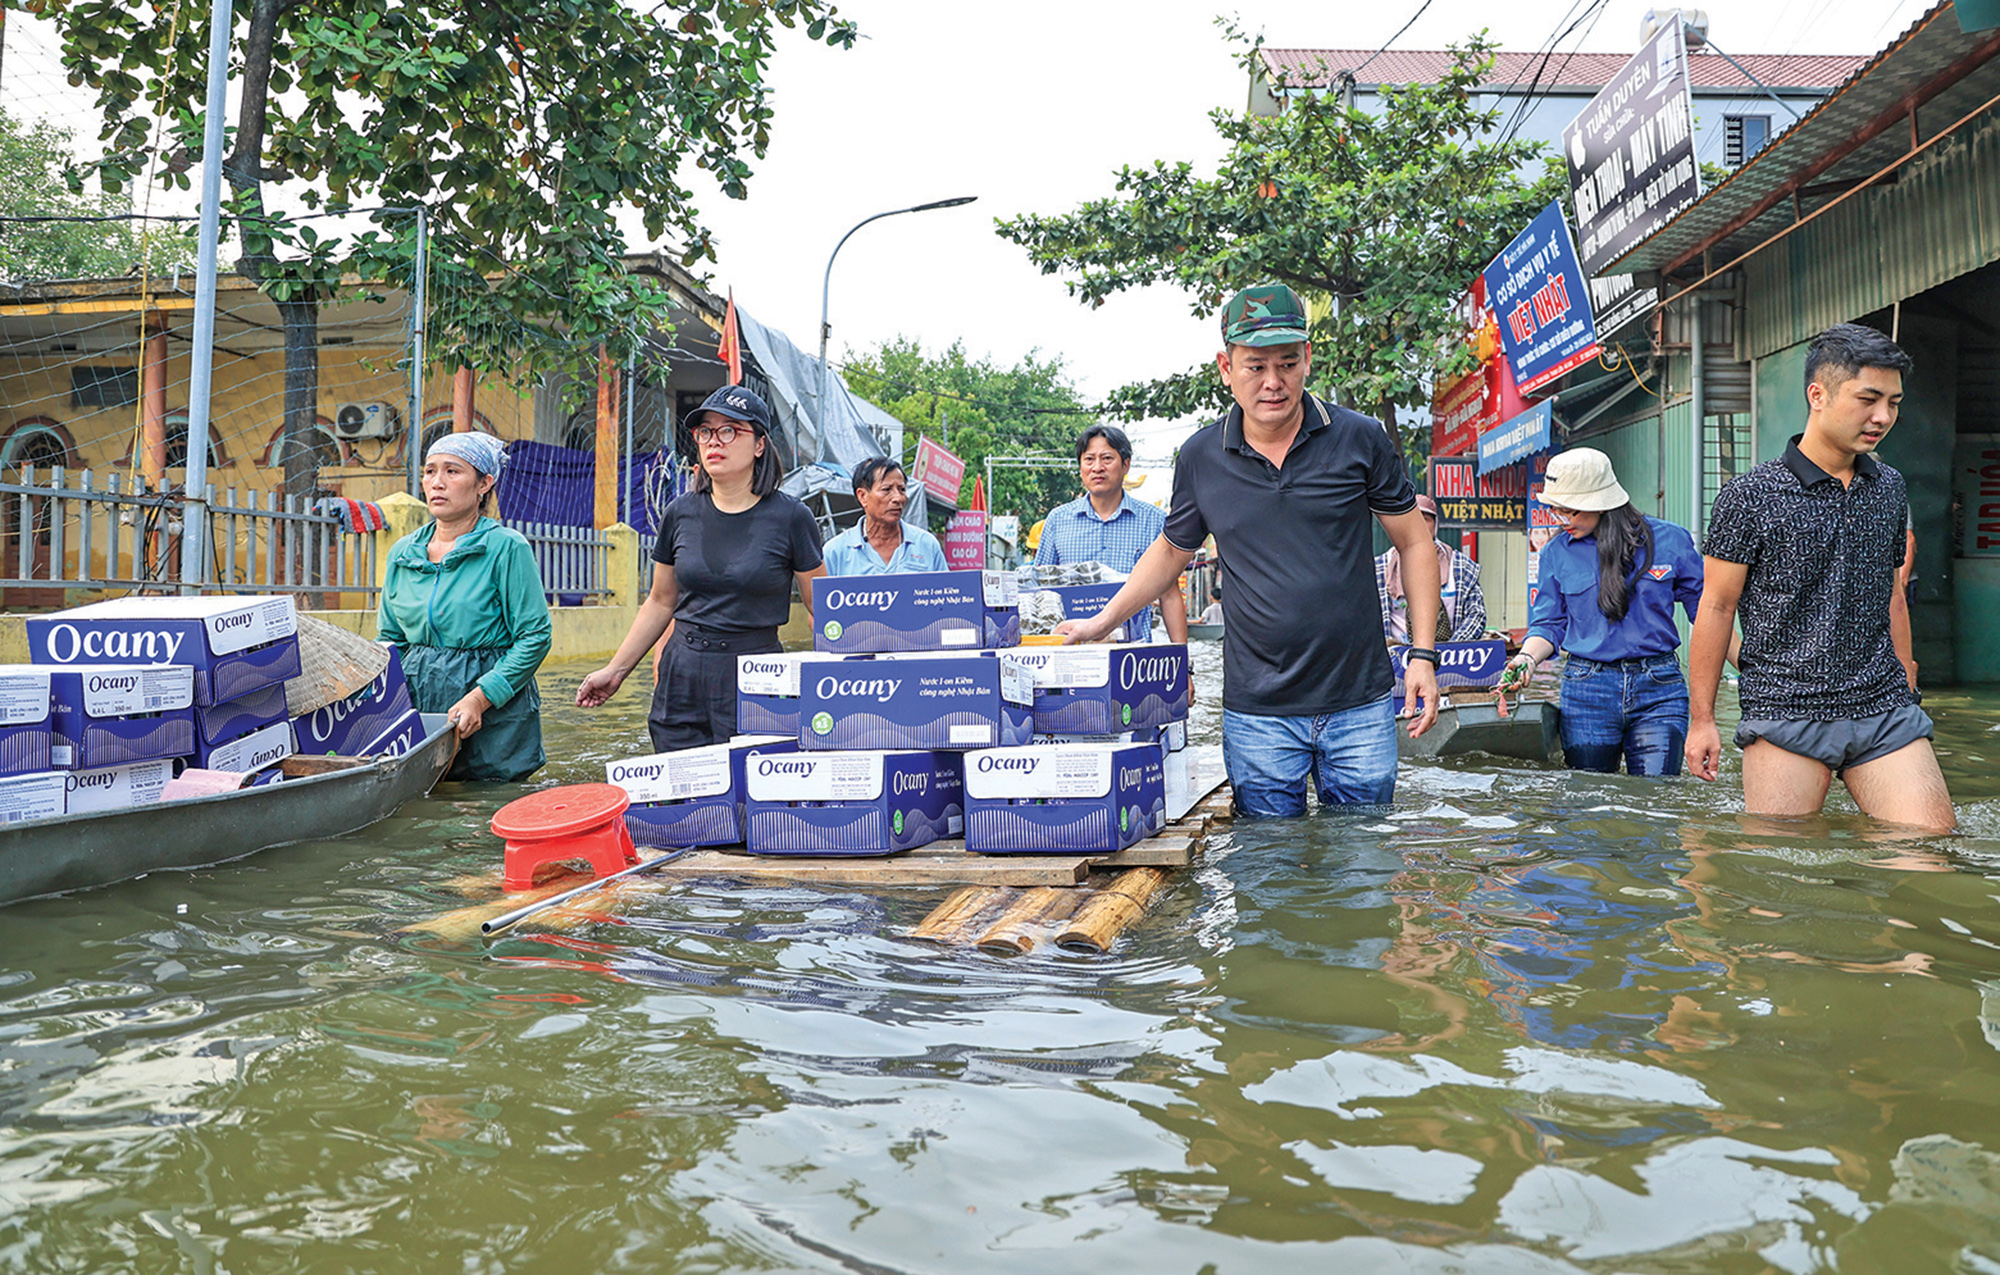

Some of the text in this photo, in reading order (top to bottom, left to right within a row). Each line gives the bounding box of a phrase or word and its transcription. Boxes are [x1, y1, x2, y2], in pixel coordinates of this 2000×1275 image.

[1586, 61, 1651, 139] TUẤN DUYÊN
[1574, 173, 1598, 230] ĐIỆN
[1594, 147, 1625, 209] THOẠI
[1629, 114, 1657, 179] MÁY
[1656, 89, 1689, 156] TÍNH
[1496, 229, 1561, 305] CƠ SỞ DỊCH VỤ Y TẾ
[1507, 299, 1537, 345] VIỆT
[1531, 272, 1571, 329] NHẬT
[1510, 423, 1525, 447] VIỆT
[1435, 464, 1475, 498] NHA
[1479, 464, 1527, 498] KHOA
[1441, 500, 1525, 523] VIỆT NHẬT
[952, 544, 978, 559] CAO CẤP
[826, 589, 899, 611] Ocany
[214, 611, 254, 633] Ocany
[47, 623, 185, 665] Ocany
[742, 660, 787, 677] Ocany
[1120, 652, 1181, 692] Ocany
[89, 675, 139, 693] Ocany
[816, 676, 902, 702] Ocany
[920, 677, 938, 686] Nước
[920, 688, 935, 697] công
[937, 688, 956, 697] nghệ
[957, 686, 975, 697] Nhật
[249, 744, 285, 768] Ocany
[978, 755, 1040, 774] Ocany
[613, 764, 664, 782] Ocany
[758, 759, 817, 778] Ocany
[1120, 766, 1142, 792] Ocany
[66, 771, 118, 793] Ocany
[893, 771, 930, 796] Ocany
